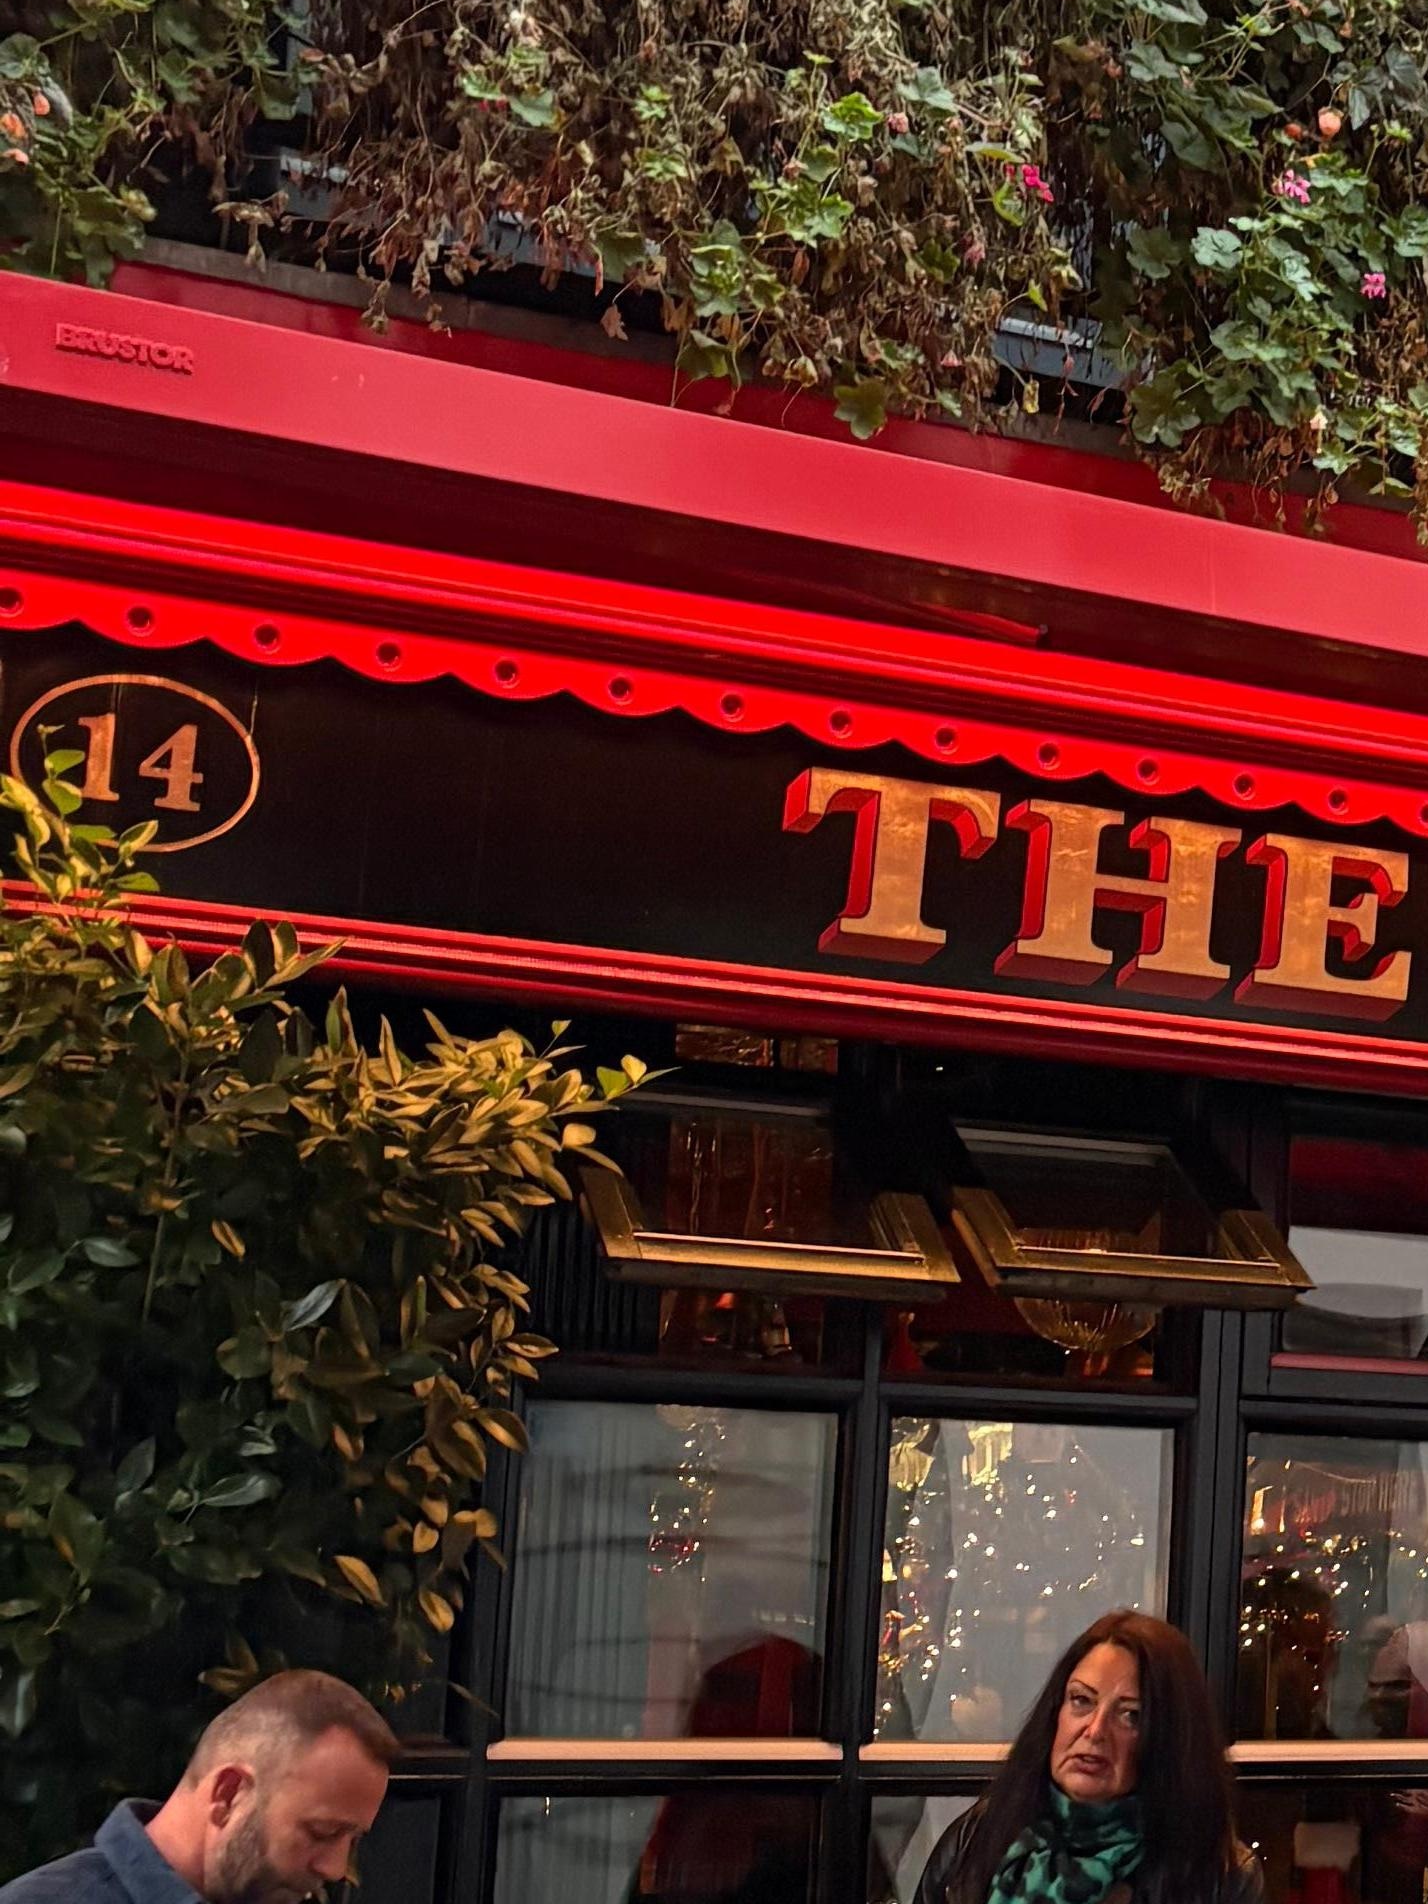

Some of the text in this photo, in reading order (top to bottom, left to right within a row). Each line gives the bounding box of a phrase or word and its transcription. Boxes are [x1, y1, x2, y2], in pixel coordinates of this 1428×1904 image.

[56, 323, 193, 375] BRUSTOR
[78, 712, 203, 812] 14
[783, 767, 1415, 1023] THE
